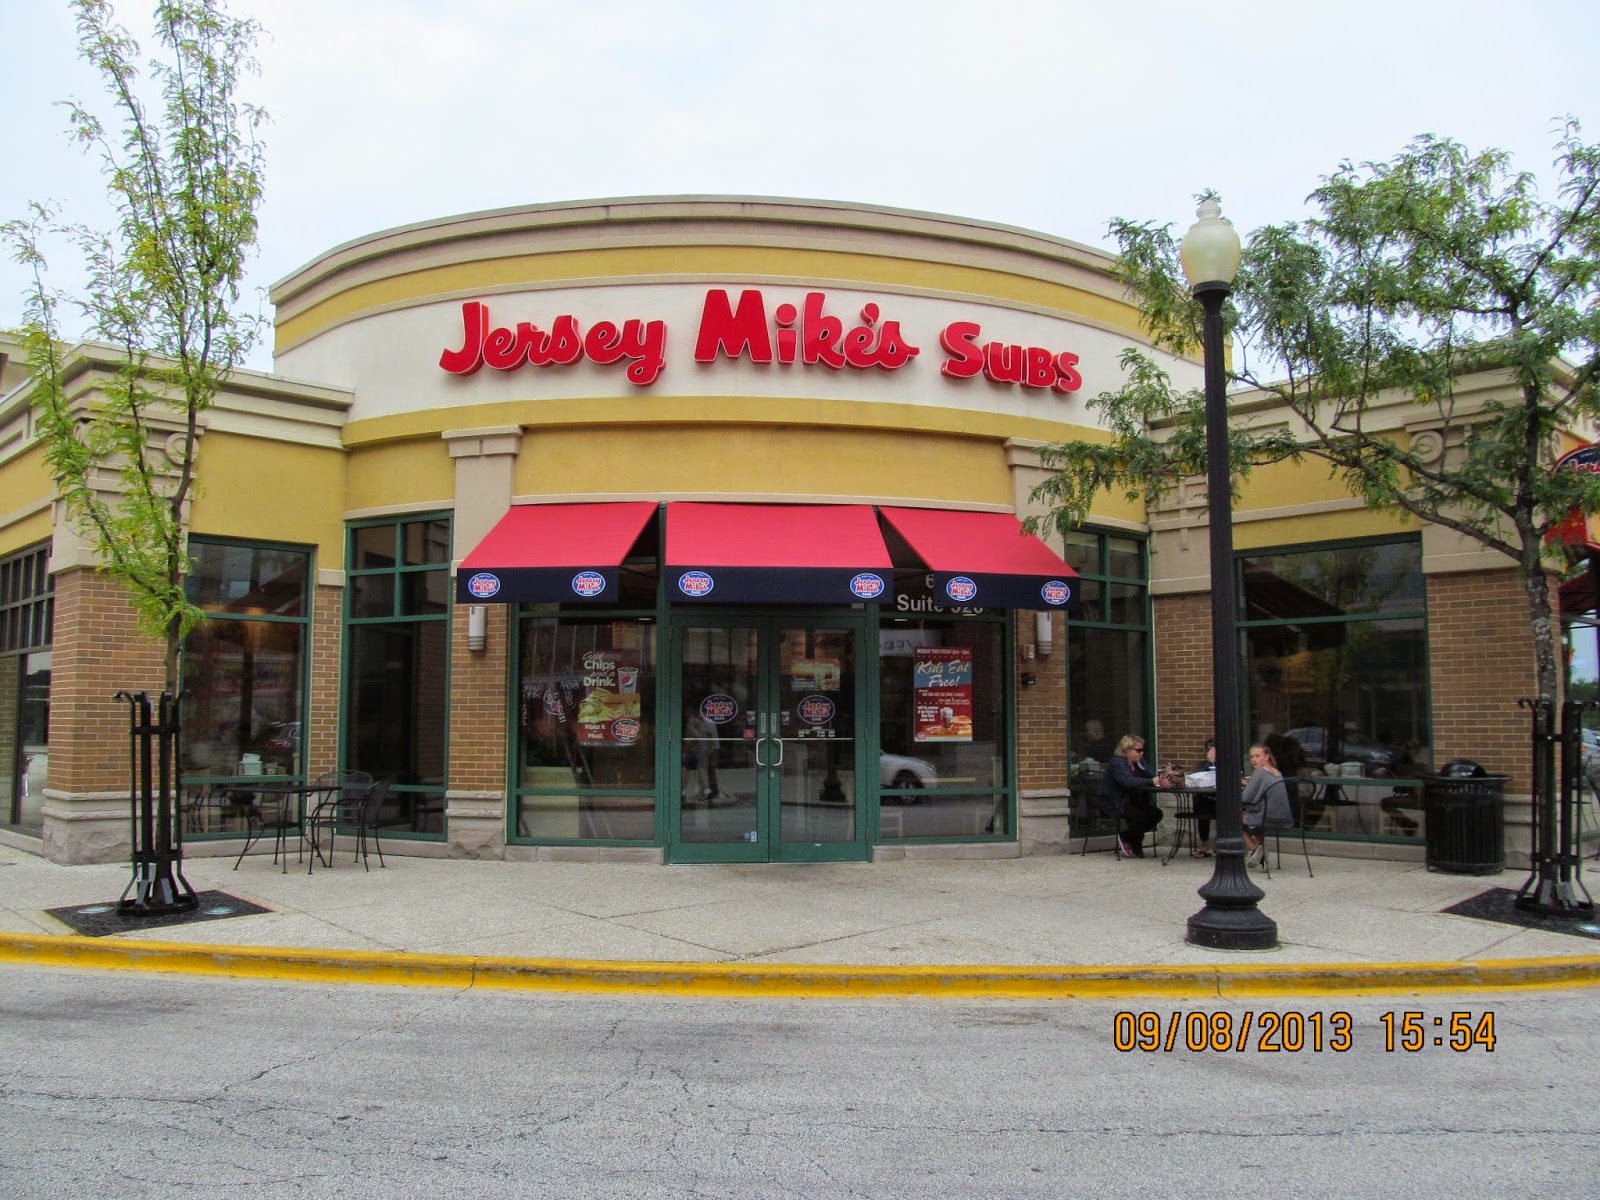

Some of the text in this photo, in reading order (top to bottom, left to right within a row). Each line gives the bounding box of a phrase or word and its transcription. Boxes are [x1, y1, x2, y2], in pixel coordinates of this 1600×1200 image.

[438, 301, 668, 388] Jersey
[694, 288, 920, 369] Mike's
[584, 660, 616, 671] Chips
[916, 659, 970, 674] Kids Eat
[583, 677, 616, 687] Drink.
[928, 674, 960, 688] Free!
[705, 700, 733, 710] Jersey
[803, 700, 831, 711] Jersey
